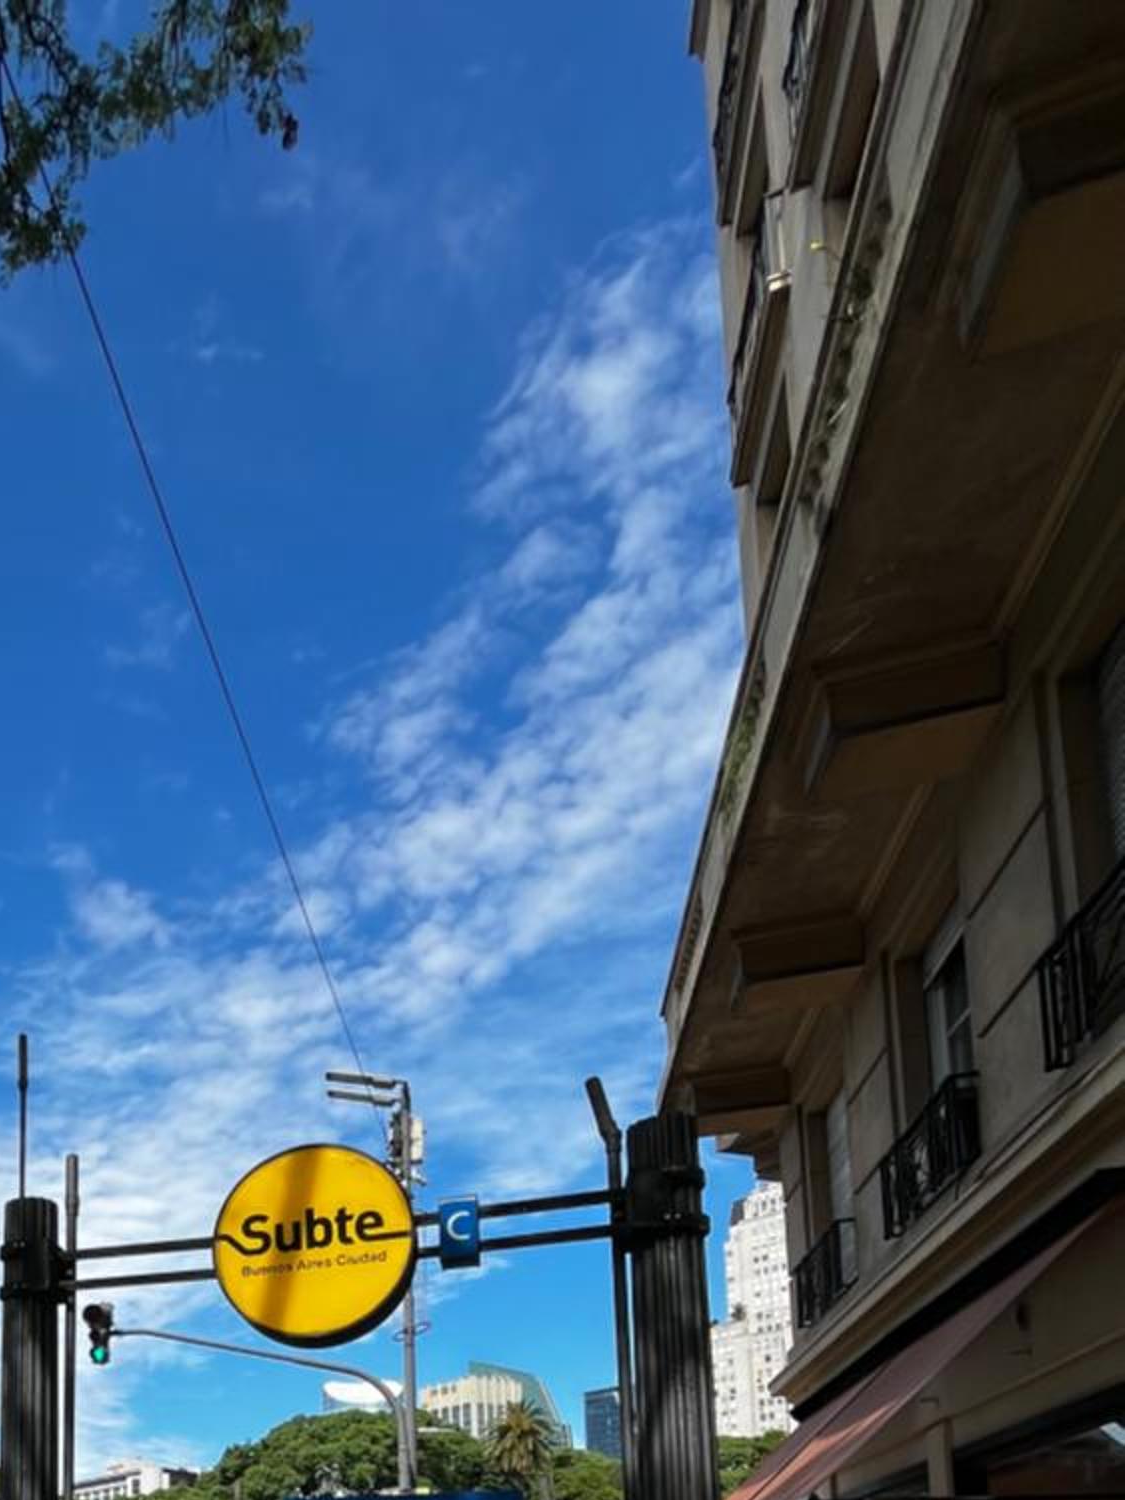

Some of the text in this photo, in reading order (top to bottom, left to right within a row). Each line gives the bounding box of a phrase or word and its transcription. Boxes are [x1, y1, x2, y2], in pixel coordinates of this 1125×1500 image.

[235, 1207, 387, 1257] Subte
[446, 1210, 471, 1240] C
[241, 1249, 388, 1278] Buenos Aires Ciudad
